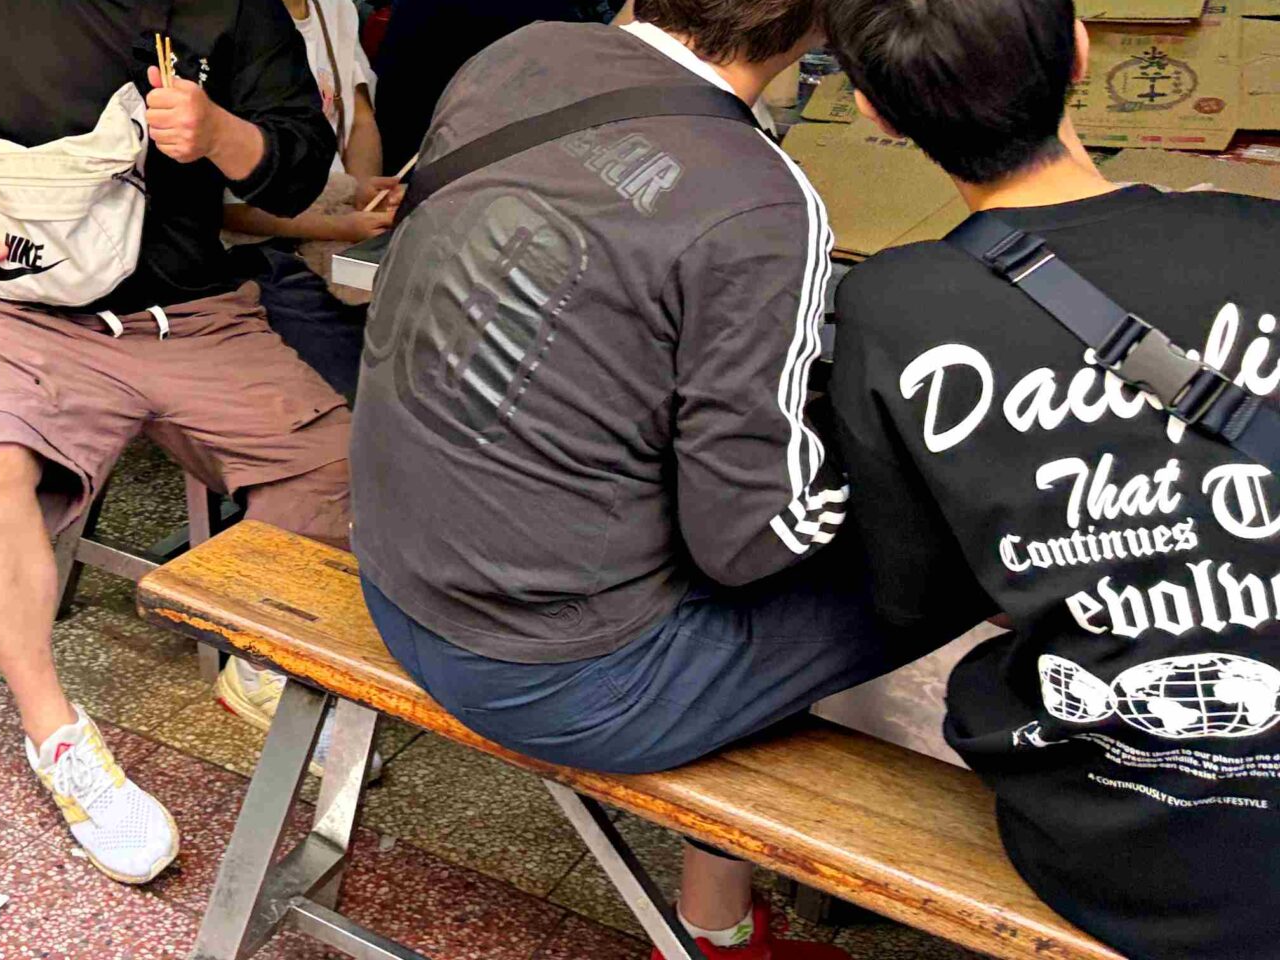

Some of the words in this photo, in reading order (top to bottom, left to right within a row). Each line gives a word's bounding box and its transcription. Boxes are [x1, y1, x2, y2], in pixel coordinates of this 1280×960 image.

[4, 232, 45, 268] NIKE
[1036, 453, 1182, 529] That
[1000, 517, 1198, 572] Continues
[1065, 559, 1280, 638] evolv
[1218, 796, 1269, 810] LIFESTYLE
